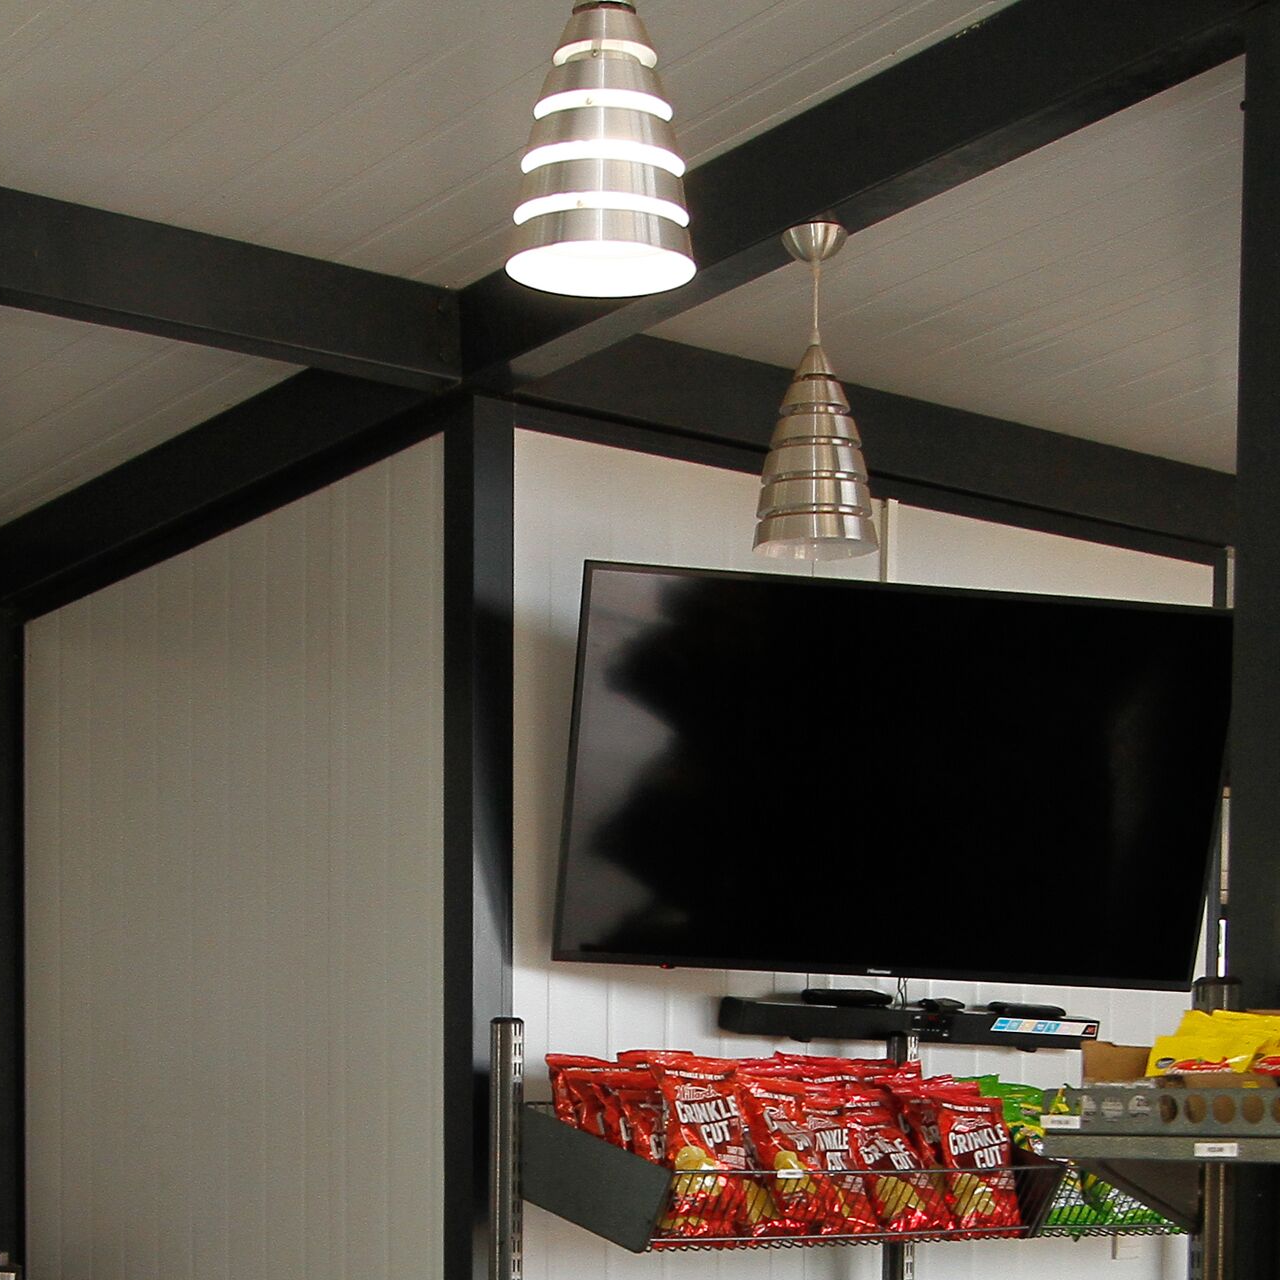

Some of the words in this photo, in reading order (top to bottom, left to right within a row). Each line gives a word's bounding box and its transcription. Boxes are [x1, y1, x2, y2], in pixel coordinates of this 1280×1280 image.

[676, 1095, 736, 1124] CRINKLE
[701, 1121, 731, 1148] CUT
[948, 1123, 1008, 1155] CRINKLE
[974, 1145, 1003, 1169] CUT
